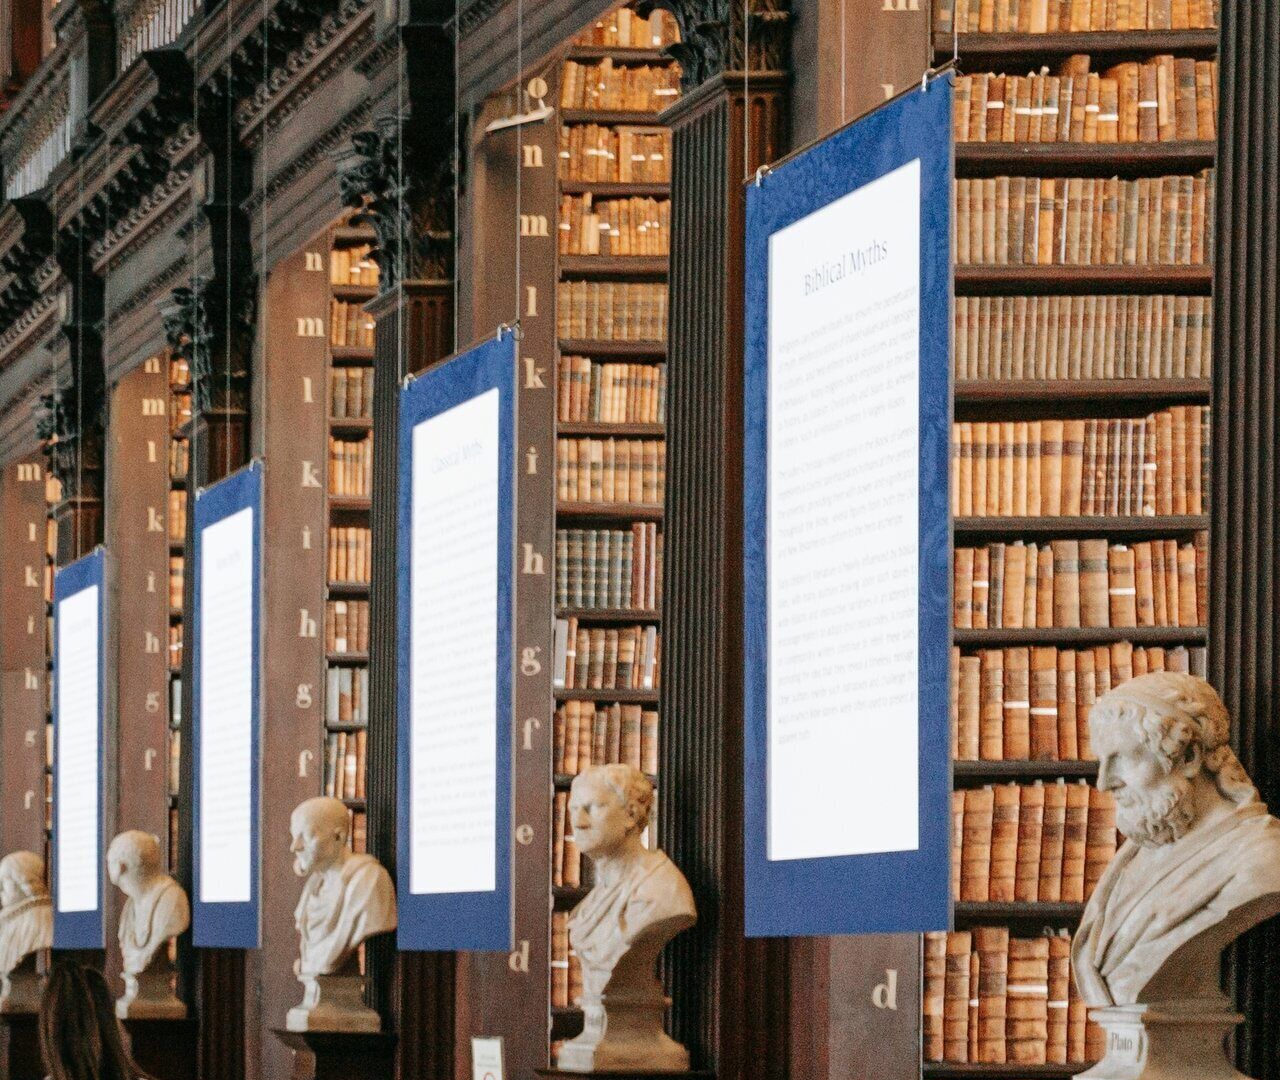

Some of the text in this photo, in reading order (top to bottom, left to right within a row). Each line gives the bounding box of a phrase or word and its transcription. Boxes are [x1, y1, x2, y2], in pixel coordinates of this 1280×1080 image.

[526, 77, 547, 101] o
[524, 145, 543, 167] n
[519, 215, 548, 236] m
[306, 253, 323, 271] n
[804, 239, 889, 296] Biblical Myths
[527, 286, 536, 316] l
[298, 318, 324, 336] m
[145, 358, 160, 373] n
[525, 358, 545, 388] k
[304, 377, 312, 402] l
[143, 399, 164, 415] m
[148, 441, 156, 462] l
[527, 447, 537, 474] i
[18, 464, 41, 481] m
[302, 461, 321, 487] k
[148, 507, 163, 531] k
[29, 523, 36, 541] l
[303, 526, 311, 548] i
[523, 544, 544, 574] h
[26, 566, 38, 586] k
[148, 572, 155, 592] i
[300, 609, 316, 637] h
[146, 631, 159, 653] h
[521, 647, 541, 675] g
[25, 669, 38, 689] h
[146, 692, 159, 712] g
[297, 684, 312, 707] g
[517, 824, 532, 844] e
[509, 942, 529, 972] d
[872, 969, 897, 1009] d
[1110, 1032, 1133, 1051] Plato
